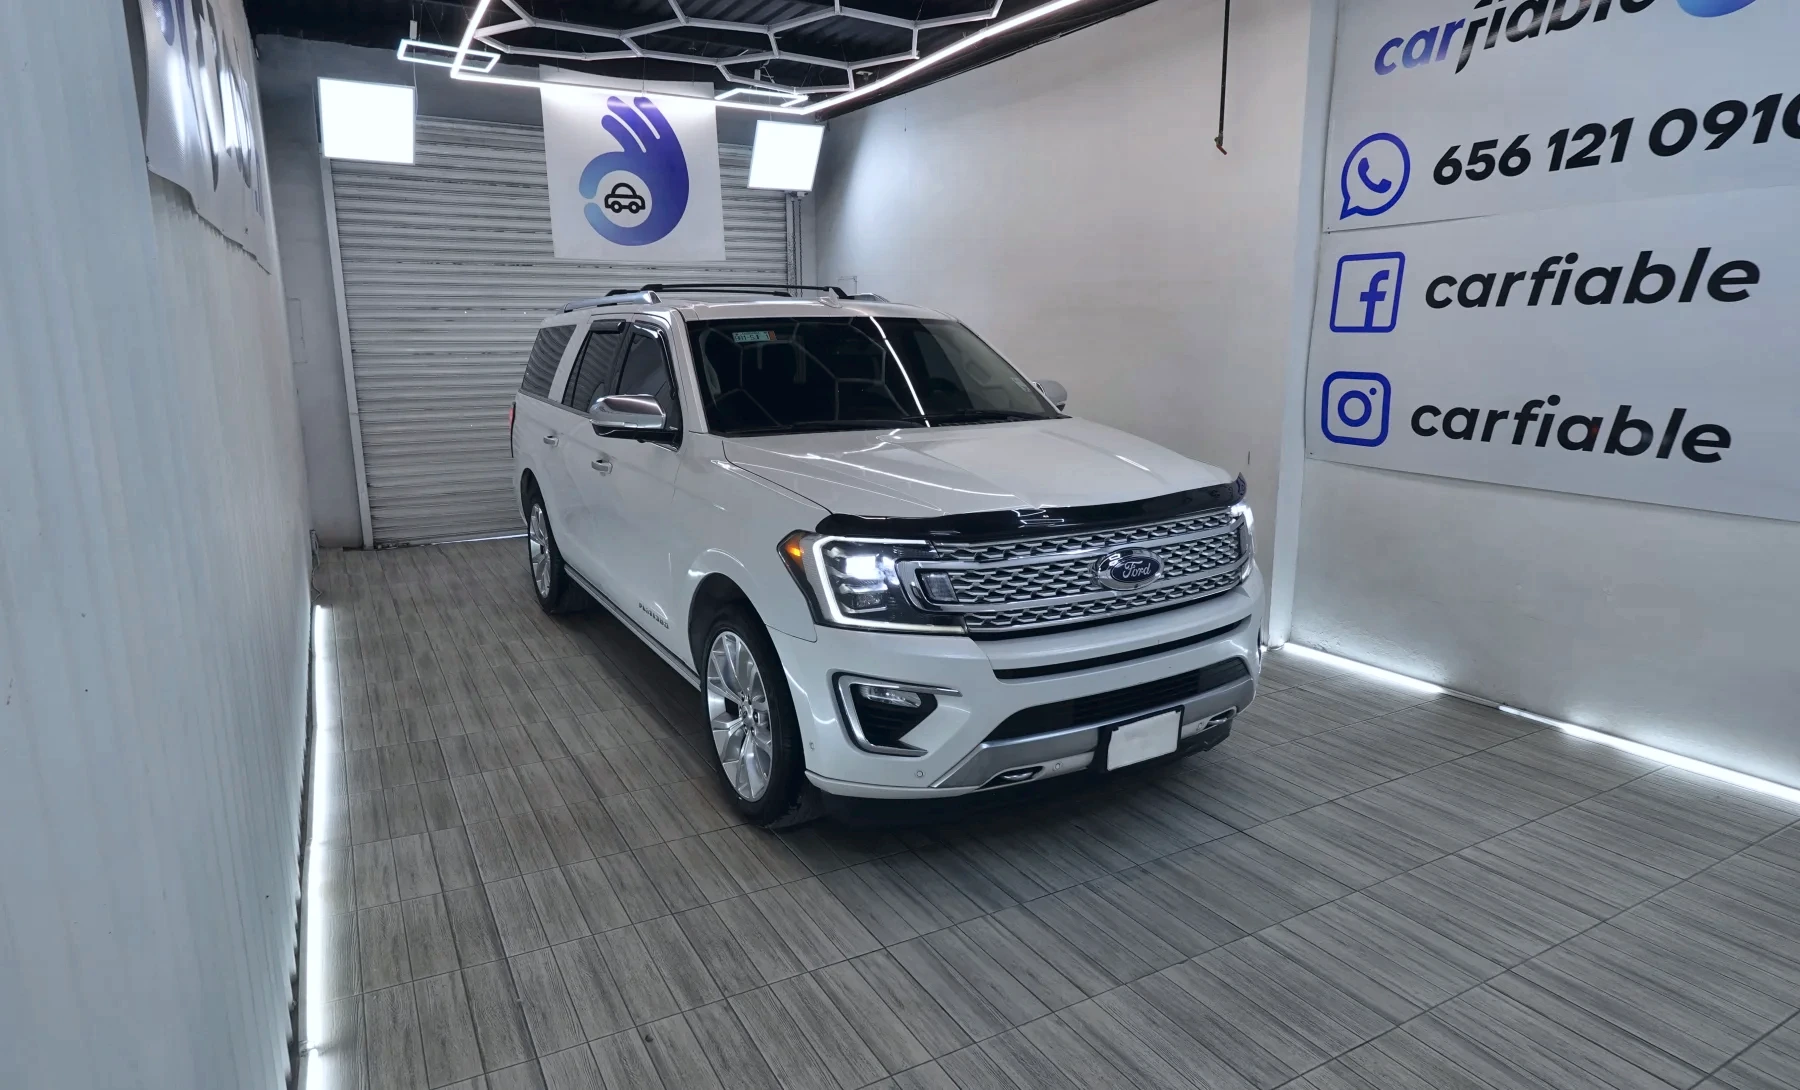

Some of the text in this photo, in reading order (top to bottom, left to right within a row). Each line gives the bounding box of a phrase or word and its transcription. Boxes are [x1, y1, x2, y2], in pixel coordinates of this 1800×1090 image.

[1433, 133, 1532, 186] 656
[1548, 117, 1635, 172] 121
[1425, 246, 1761, 310] carfiable
[1410, 394, 1732, 464] carfiable
[1122, 560, 1152, 579] Ford
